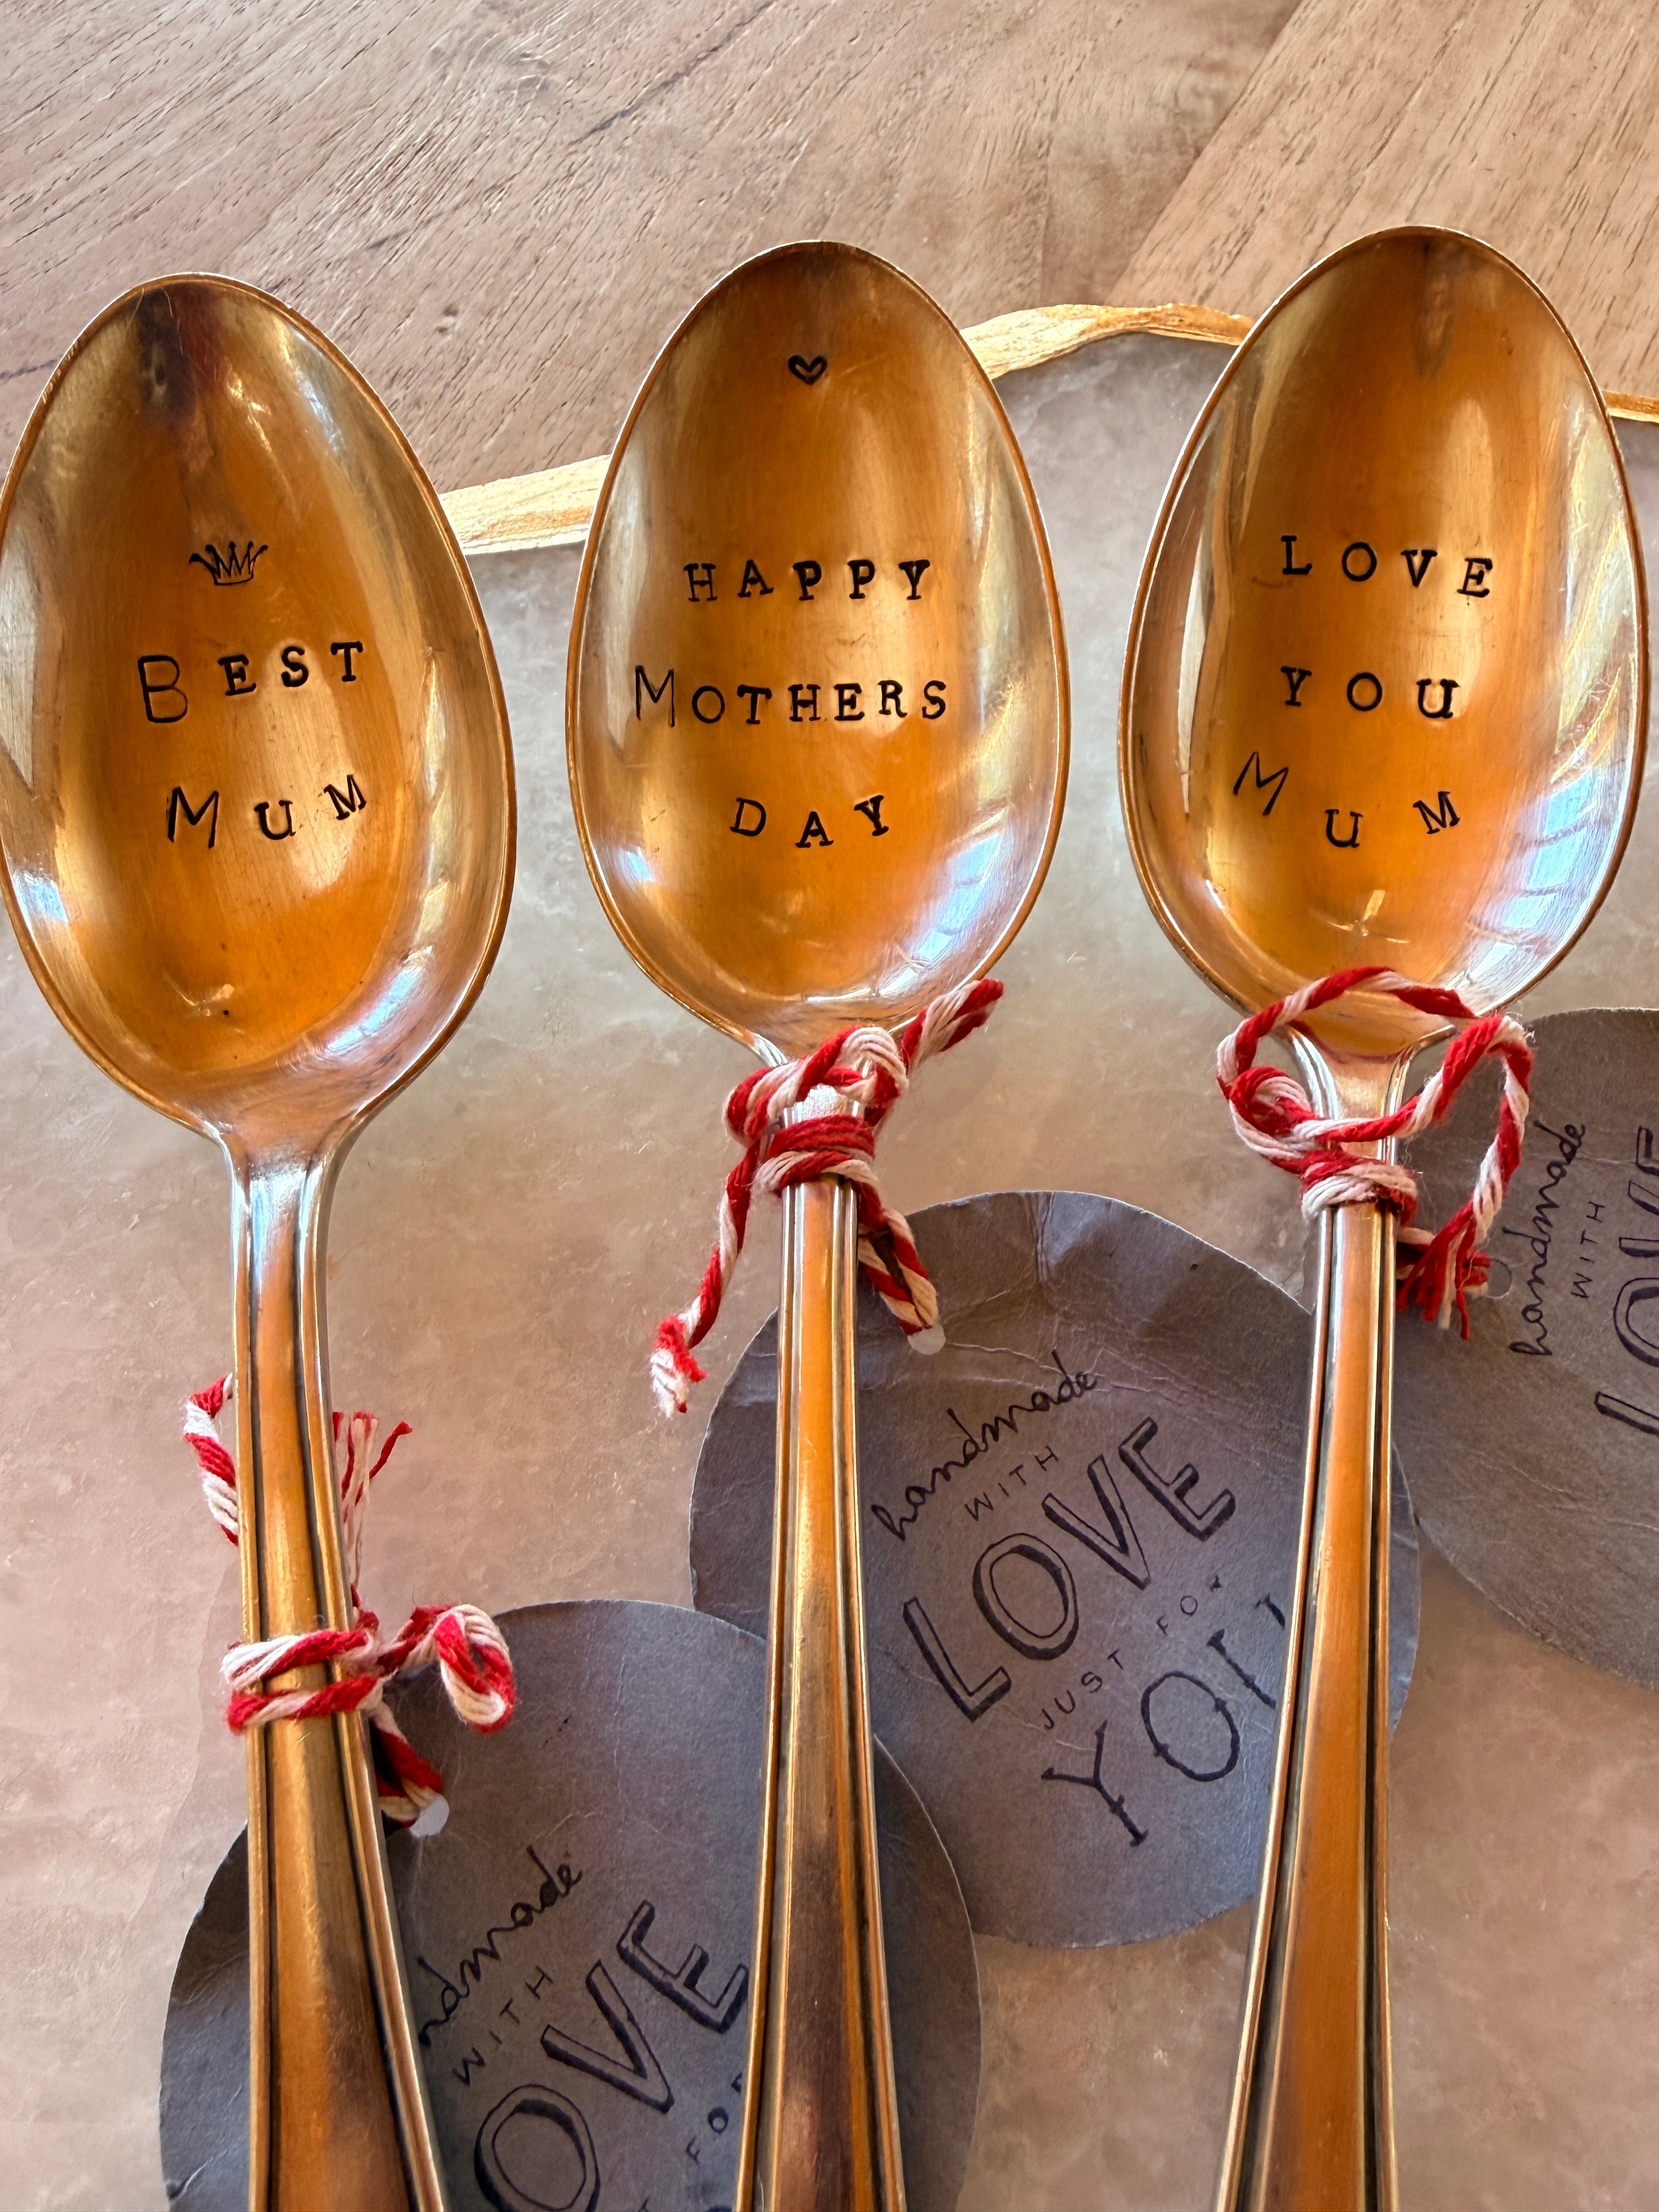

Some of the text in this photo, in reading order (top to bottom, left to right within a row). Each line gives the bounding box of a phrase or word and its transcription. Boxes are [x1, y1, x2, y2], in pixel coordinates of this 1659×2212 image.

[684, 559, 930, 602] HAPPY
[1280, 535, 1493, 597] LOVE
[138, 640, 364, 724] BEST
[635, 665, 947, 727] MOTHERS
[1280, 665, 1459, 719] YOU
[166, 774, 367, 849] MUM
[729, 795, 889, 848] DAY
[1233, 751, 1460, 848] MUM
[1502, 1119, 1587, 1356] handmade
[1571, 1201, 1605, 1299] WITH
[871, 1349, 1097, 1542] handmade
[964, 1446, 1059, 1521] WITH
[902, 1417, 1237, 1723] LOVE
[1042, 1649, 1125, 1731] JUST
[417, 1844, 583, 2048] dmade
[452, 1965, 554, 2086] WITH
[473, 1899, 749, 2212] OVE
